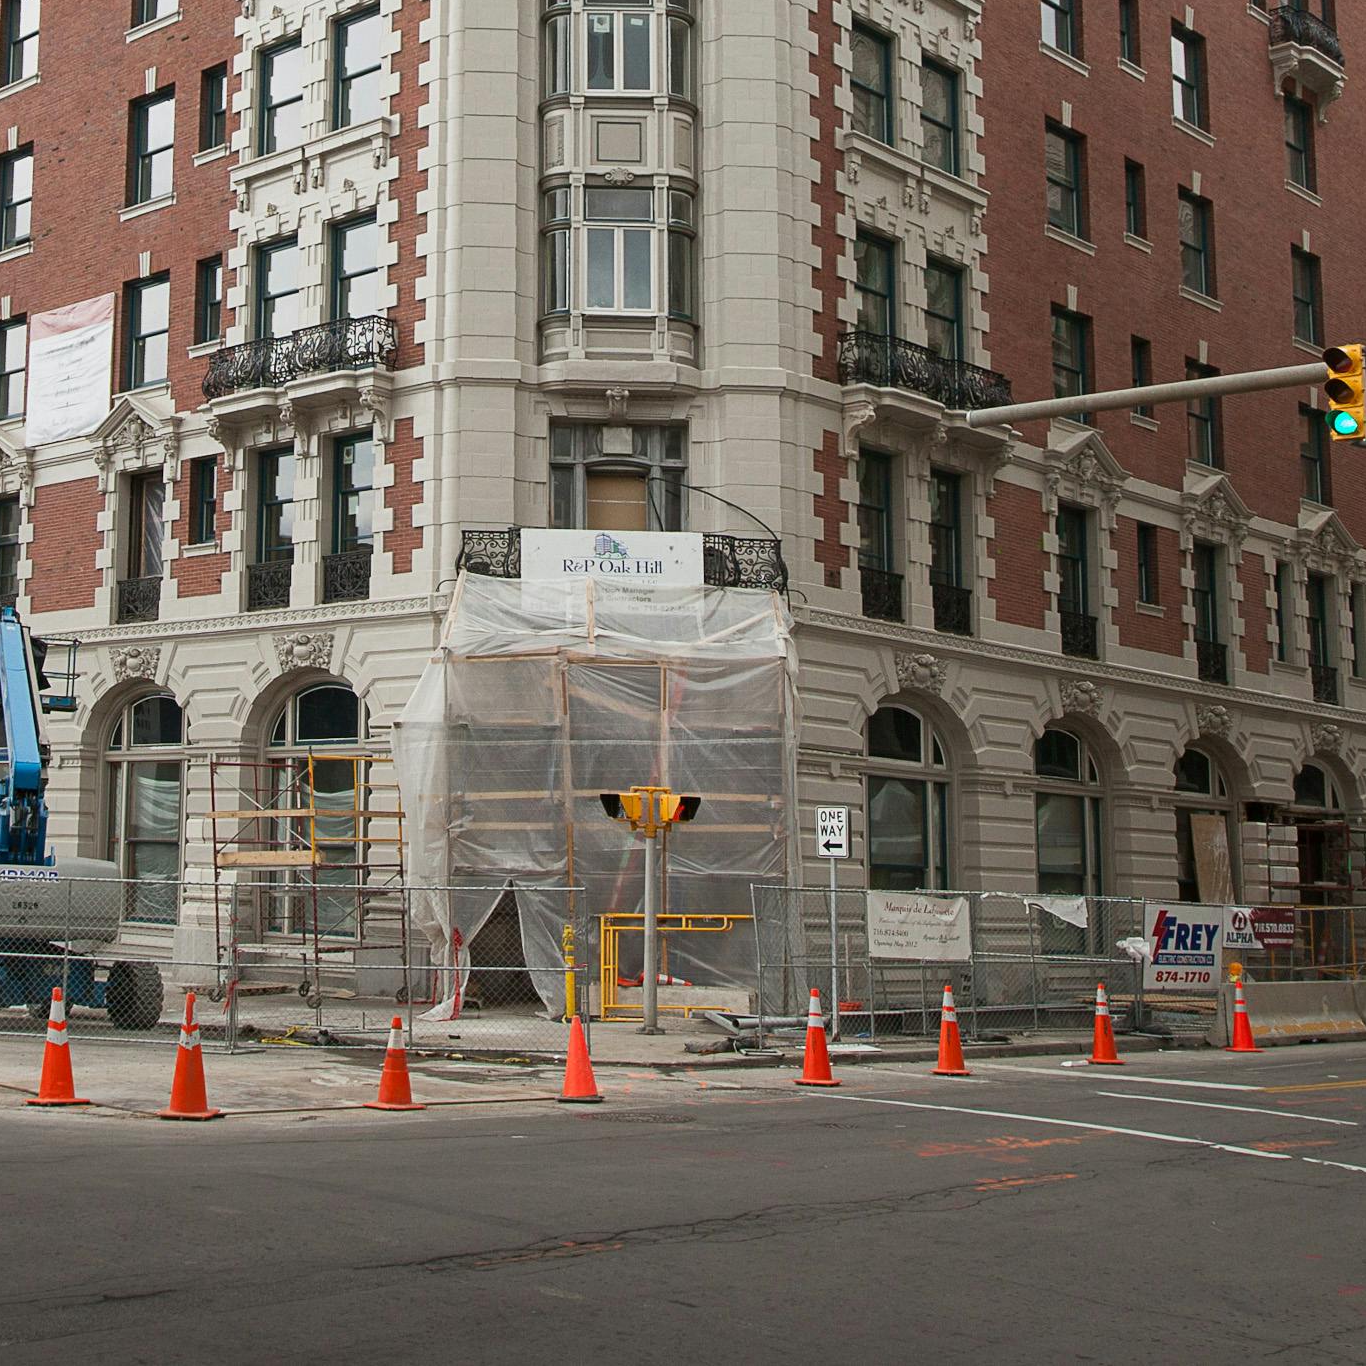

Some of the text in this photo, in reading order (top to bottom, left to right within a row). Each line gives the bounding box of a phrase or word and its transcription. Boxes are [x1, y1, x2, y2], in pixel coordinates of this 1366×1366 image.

[562, 558, 663, 574] R&P Oak Hill
[820, 811, 844, 825] ONE
[820, 825, 845, 838] WAY
[883, 901, 912, 915] Marquis
[913, 902, 922, 914] de
[1160, 915, 1220, 952] FREY
[1225, 931, 1253, 944] ALPHA
[1155, 970, 1211, 983] 874-1710
